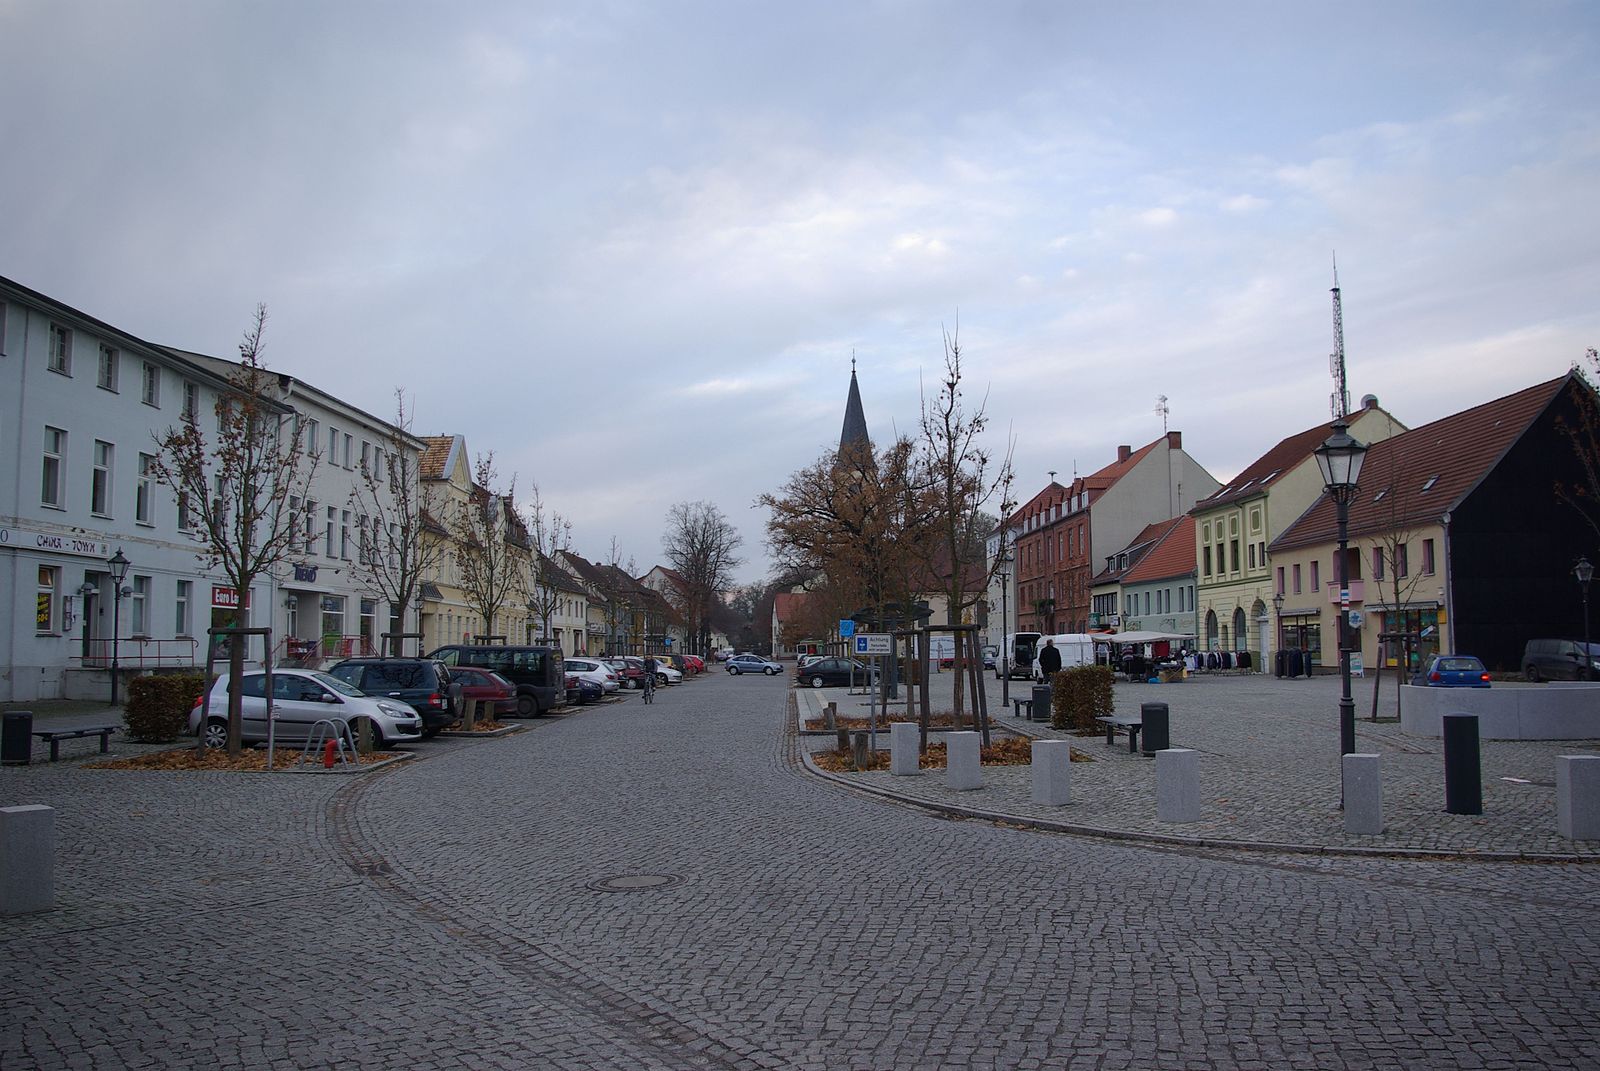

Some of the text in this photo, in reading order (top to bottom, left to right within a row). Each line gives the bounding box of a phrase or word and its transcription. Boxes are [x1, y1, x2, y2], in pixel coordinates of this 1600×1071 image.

[37, 535, 62, 549] CHINA
[72, 540, 96, 553] TOWN
[215, 588, 230, 604] Euro
